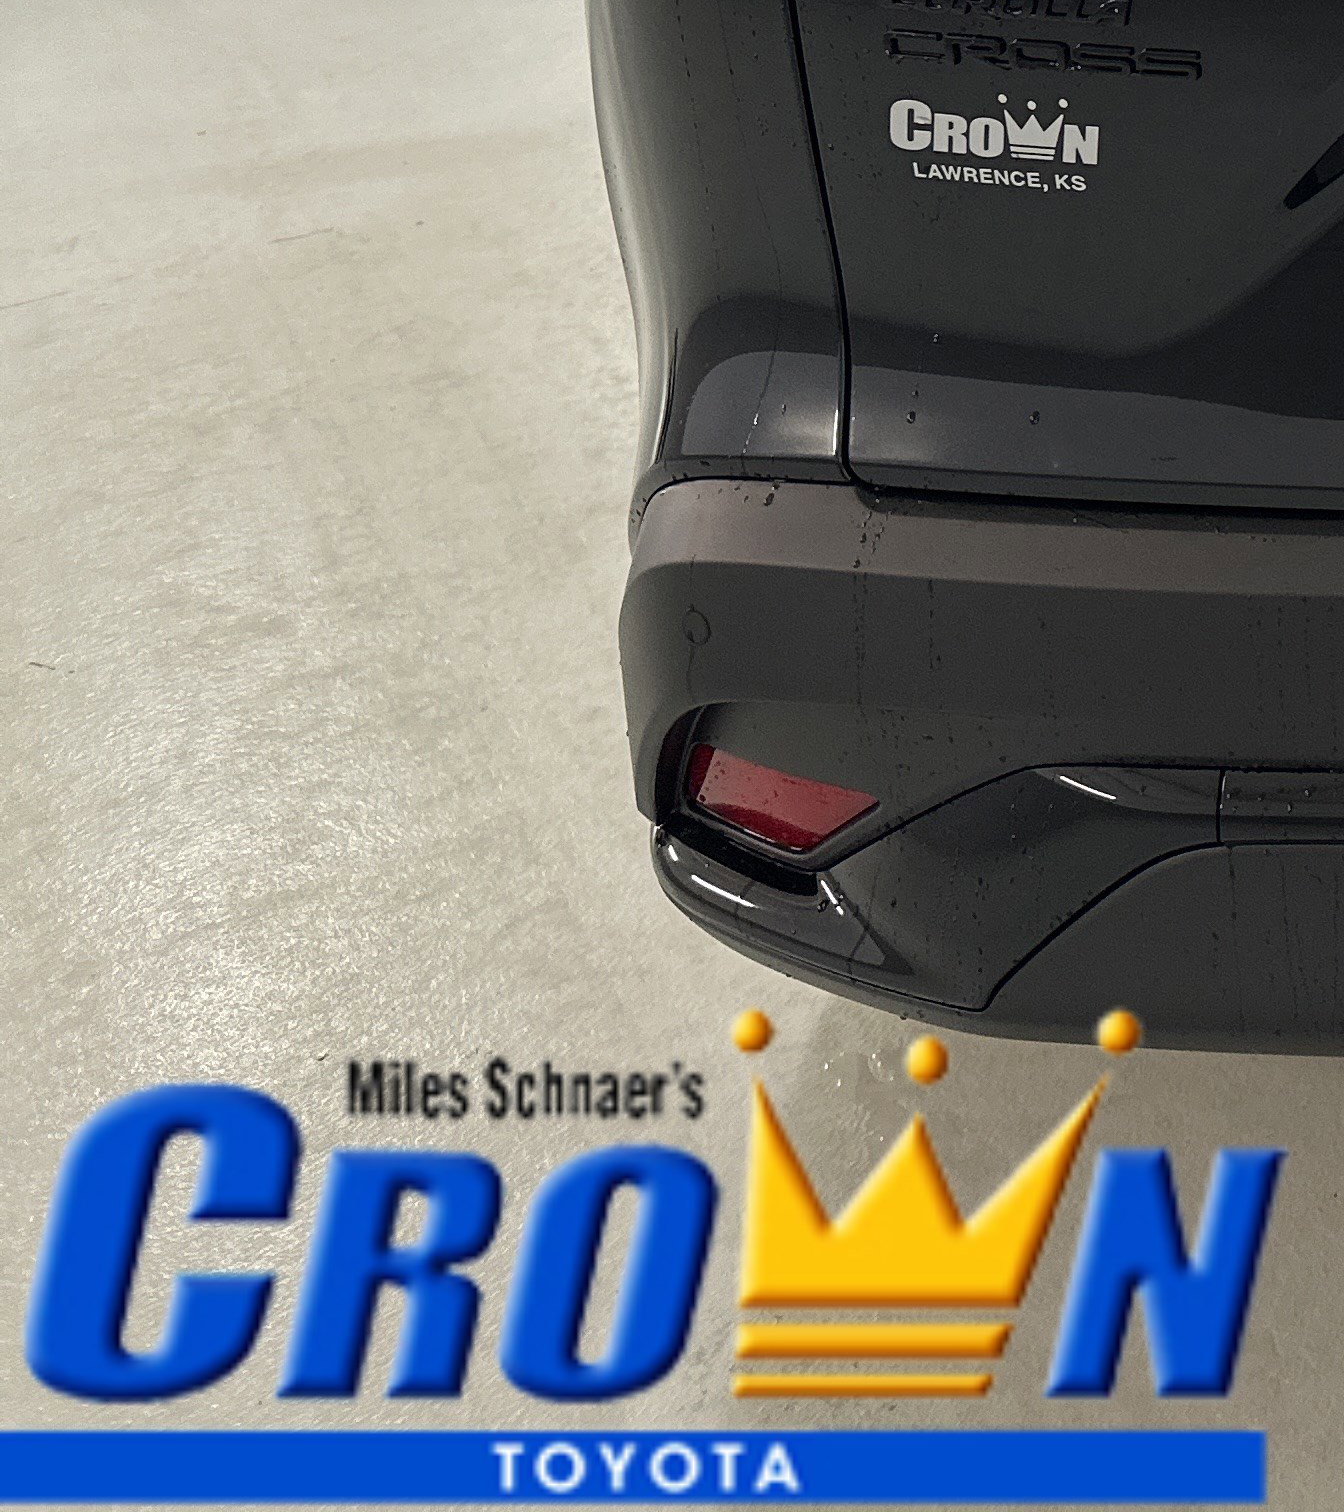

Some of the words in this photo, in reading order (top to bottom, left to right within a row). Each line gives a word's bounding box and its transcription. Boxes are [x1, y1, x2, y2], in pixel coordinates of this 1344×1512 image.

[884, 27, 1203, 80] CROSS
[912, 162, 1050, 192] LAWRENCE,
[1054, 173, 1088, 192] KS
